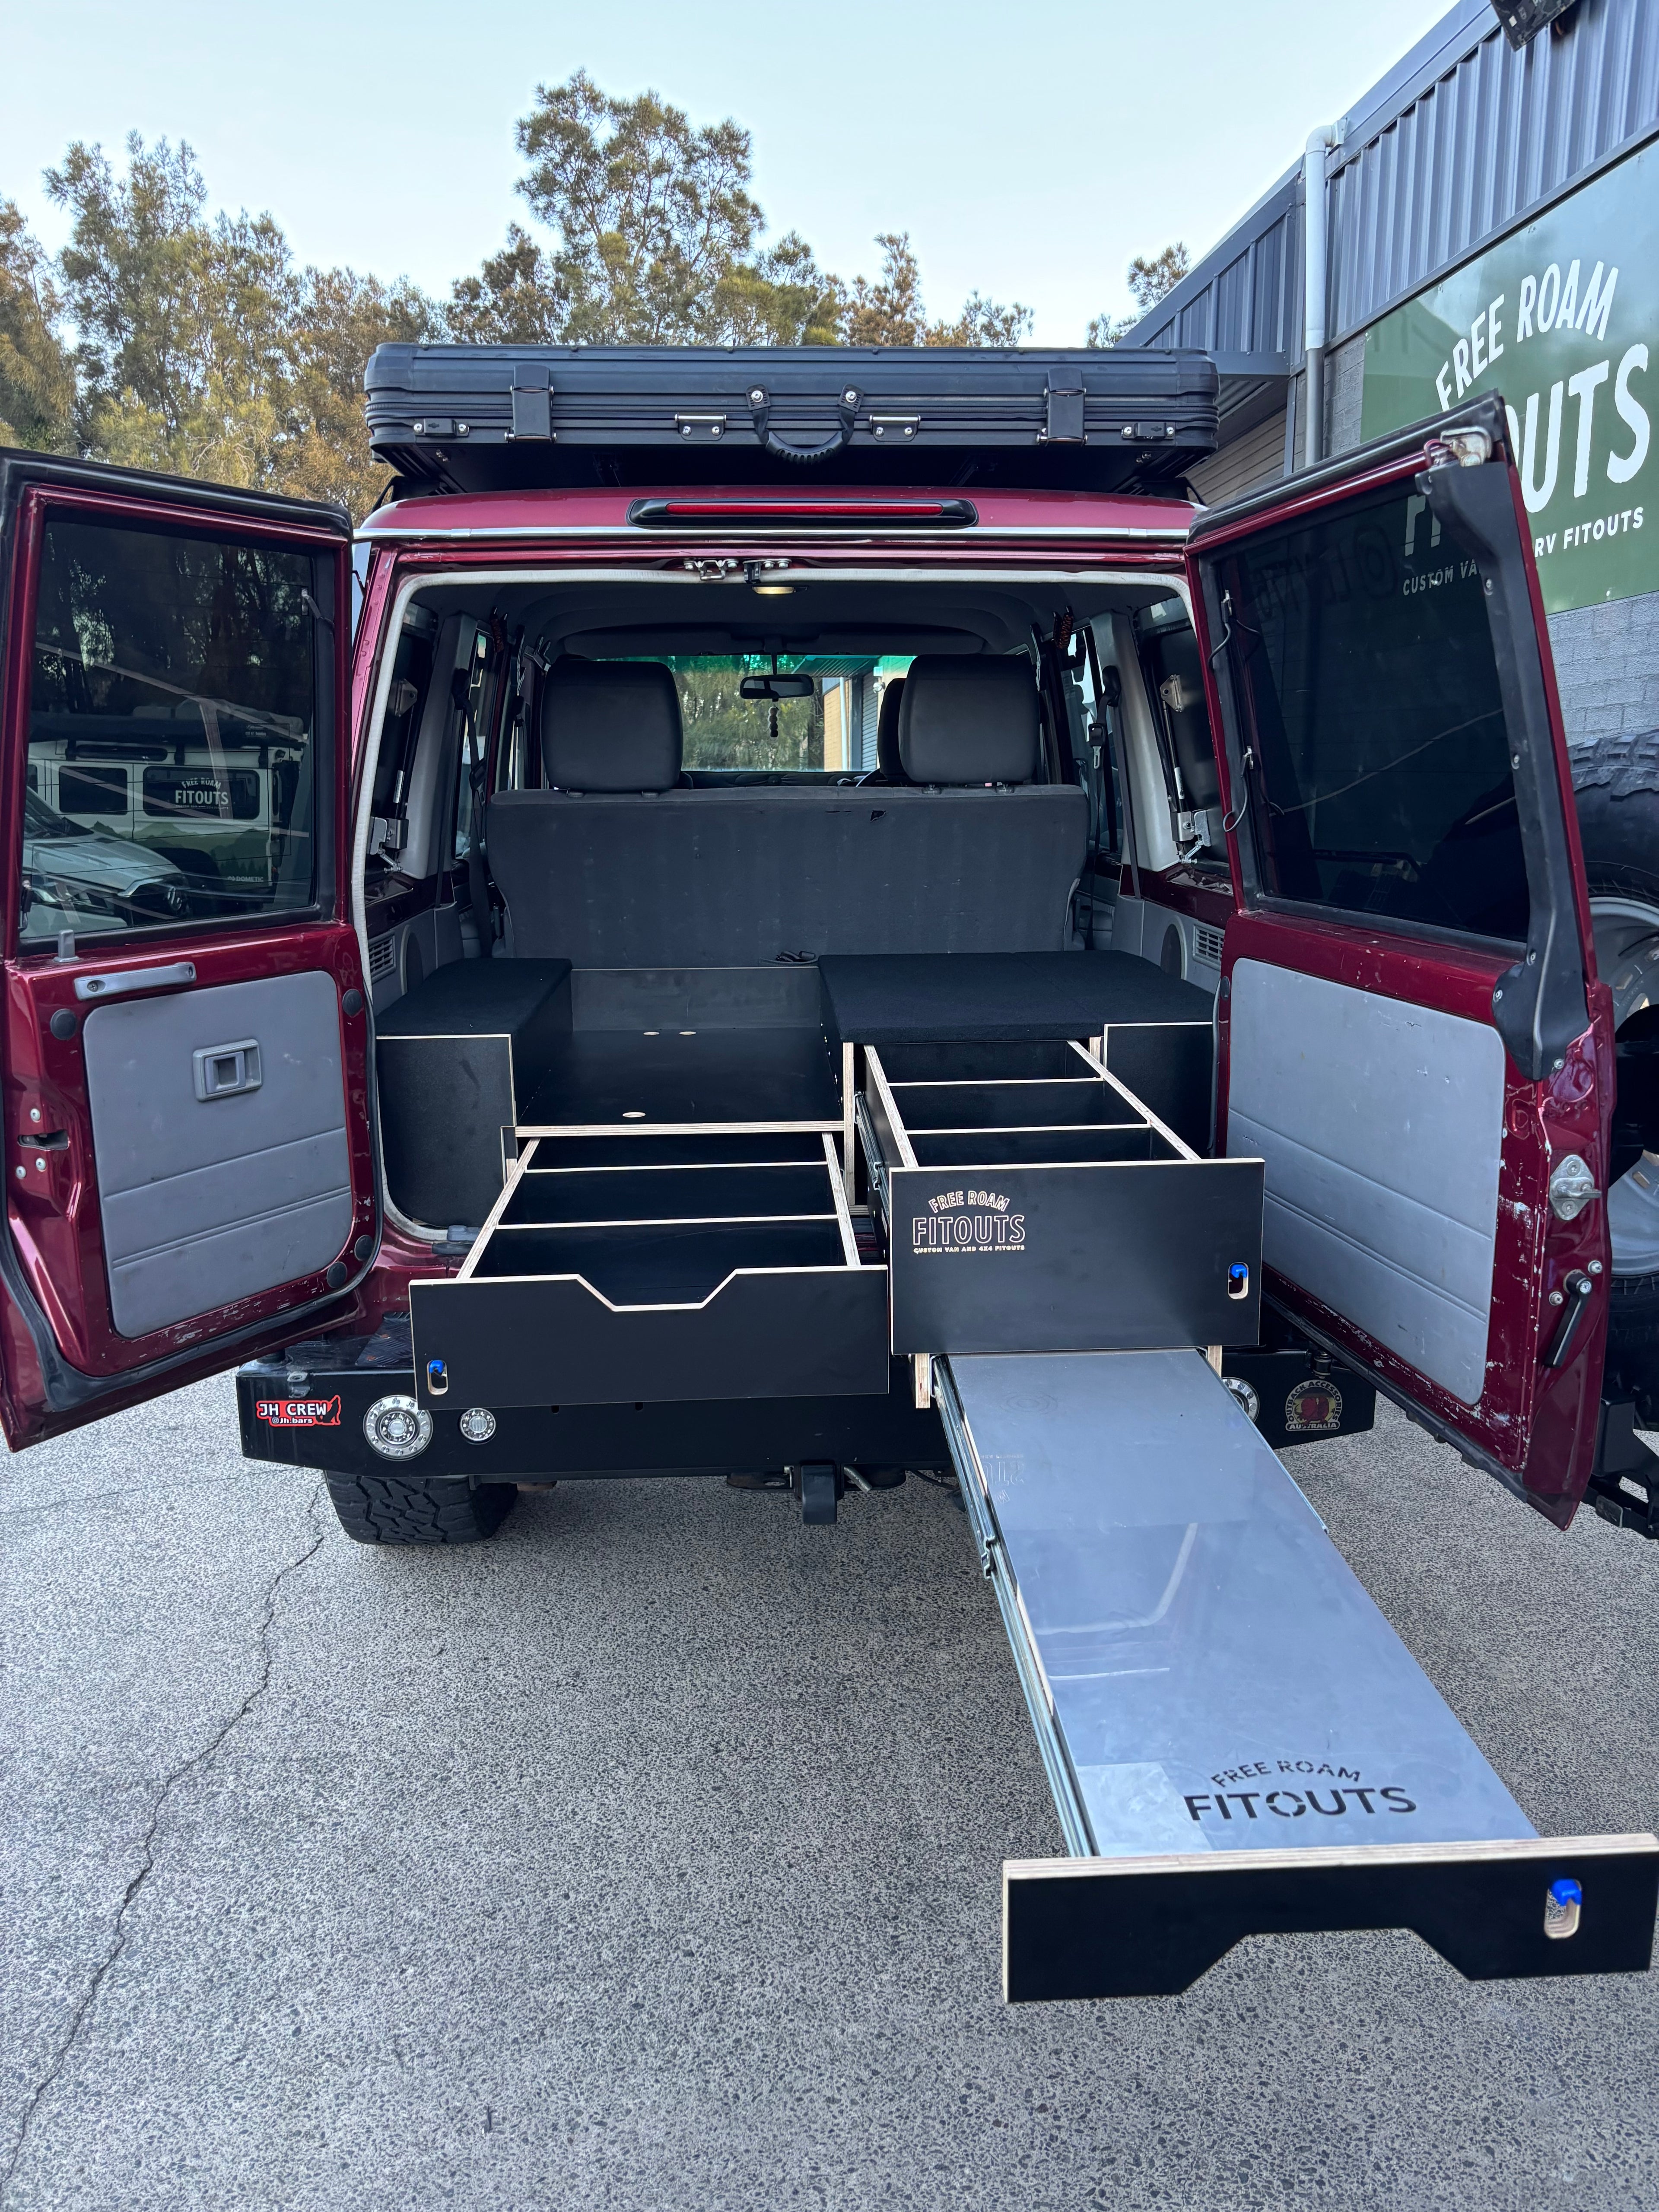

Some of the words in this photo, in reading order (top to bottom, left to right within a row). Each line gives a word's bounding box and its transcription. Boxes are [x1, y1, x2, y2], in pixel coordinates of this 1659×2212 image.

[1435, 293, 1505, 412] FREE
[1516, 259, 1619, 341] ROAM
[1403, 566, 1454, 596] CUSTOM
[1460, 559, 1478, 579] VA
[1534, 533, 1557, 558] RV
[1563, 506, 1643, 550] FITOUTS
[175, 790, 229, 805] FITOUTS
[181, 777, 199, 789] FREE
[201, 777, 222, 790] ROAM
[928, 1191, 964, 1214] FREE
[967, 1190, 1010, 1212] ROAM
[913, 1214, 1026, 1246] FITOUTS
[260, 1403, 279, 1416] JH
[286, 1403, 327, 1416] CREW
[1286, 1384, 1306, 1422] OUTBACK
[1308, 1381, 1341, 1421] ACCESSORIES
[1210, 1761, 1272, 1787] FREE
[1276, 1760, 1360, 1782] ROAM
[1183, 1786, 1416, 1821] FITOUTS
